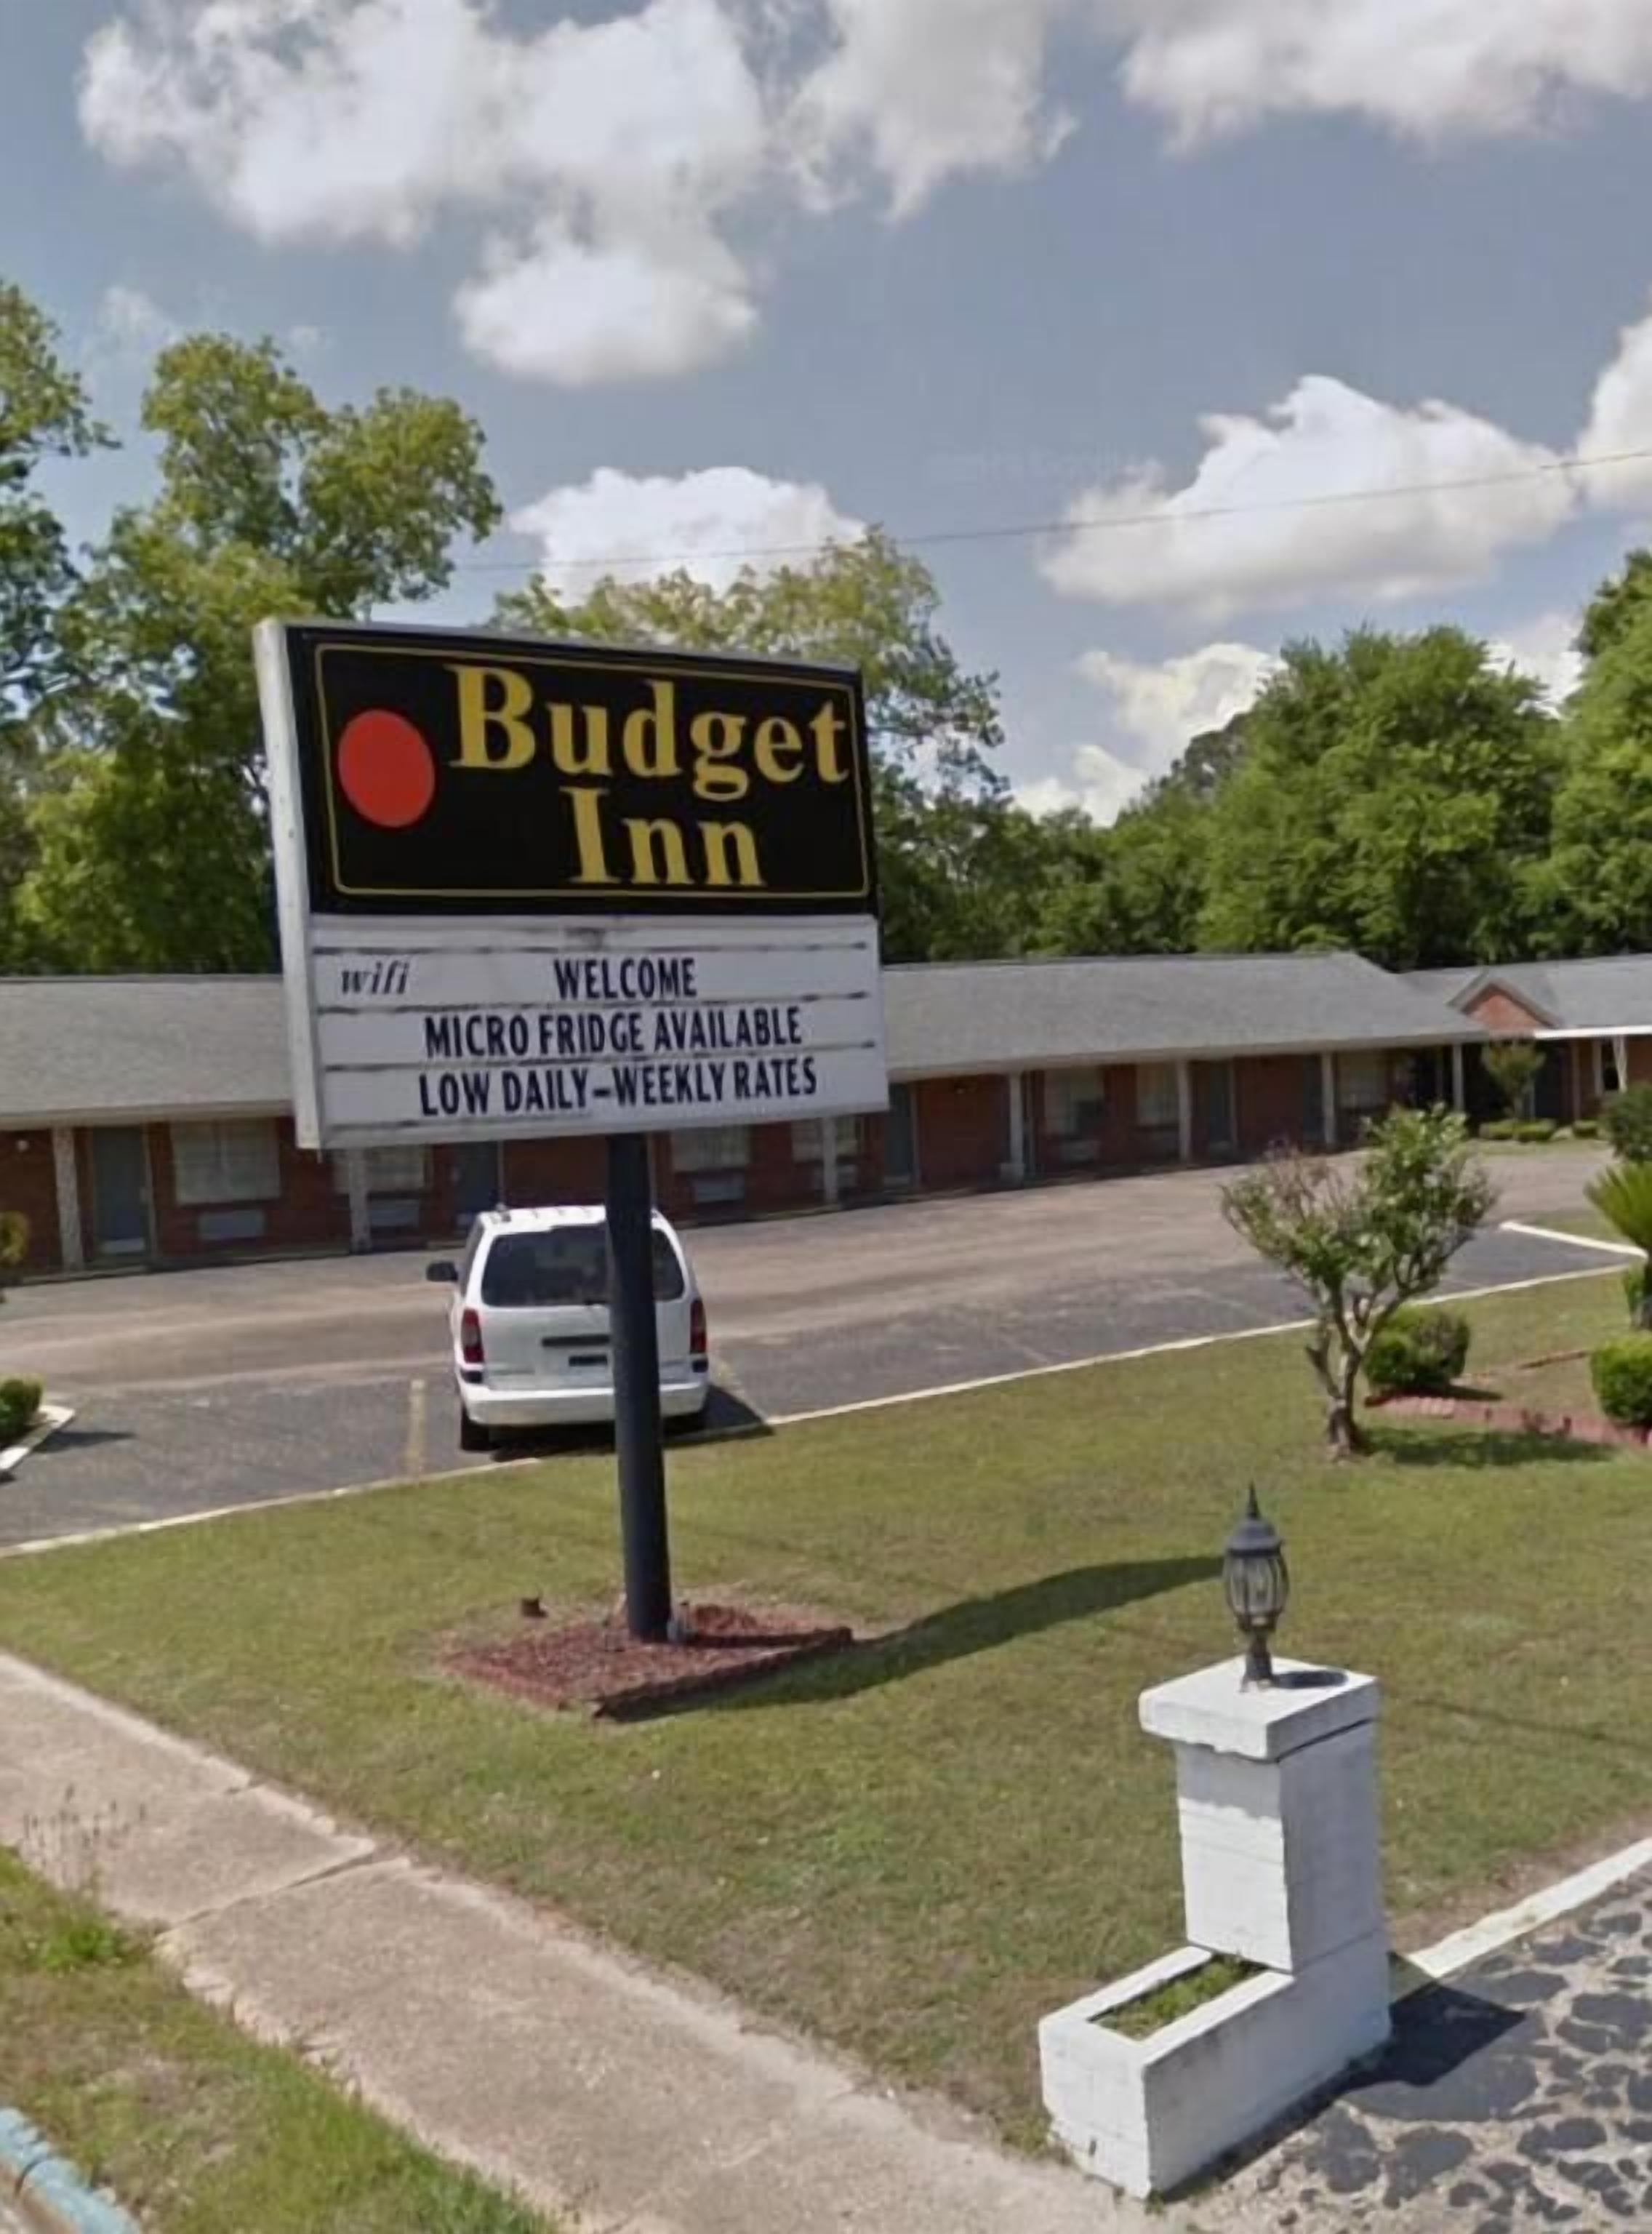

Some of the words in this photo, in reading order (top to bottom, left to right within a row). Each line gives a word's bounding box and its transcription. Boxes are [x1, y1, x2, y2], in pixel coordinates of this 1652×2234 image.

[446, 663, 851, 802] Budget
[559, 785, 767, 886] Inn
[340, 961, 409, 996] wifi
[553, 957, 697, 1001] WELCOME
[424, 1014, 529, 1059] MICRO
[538, 1012, 644, 1056] FRIDGE
[654, 1006, 803, 1052] AVAILABLE
[419, 1071, 491, 1117] LOW
[733, 1056, 817, 1099] RATES
